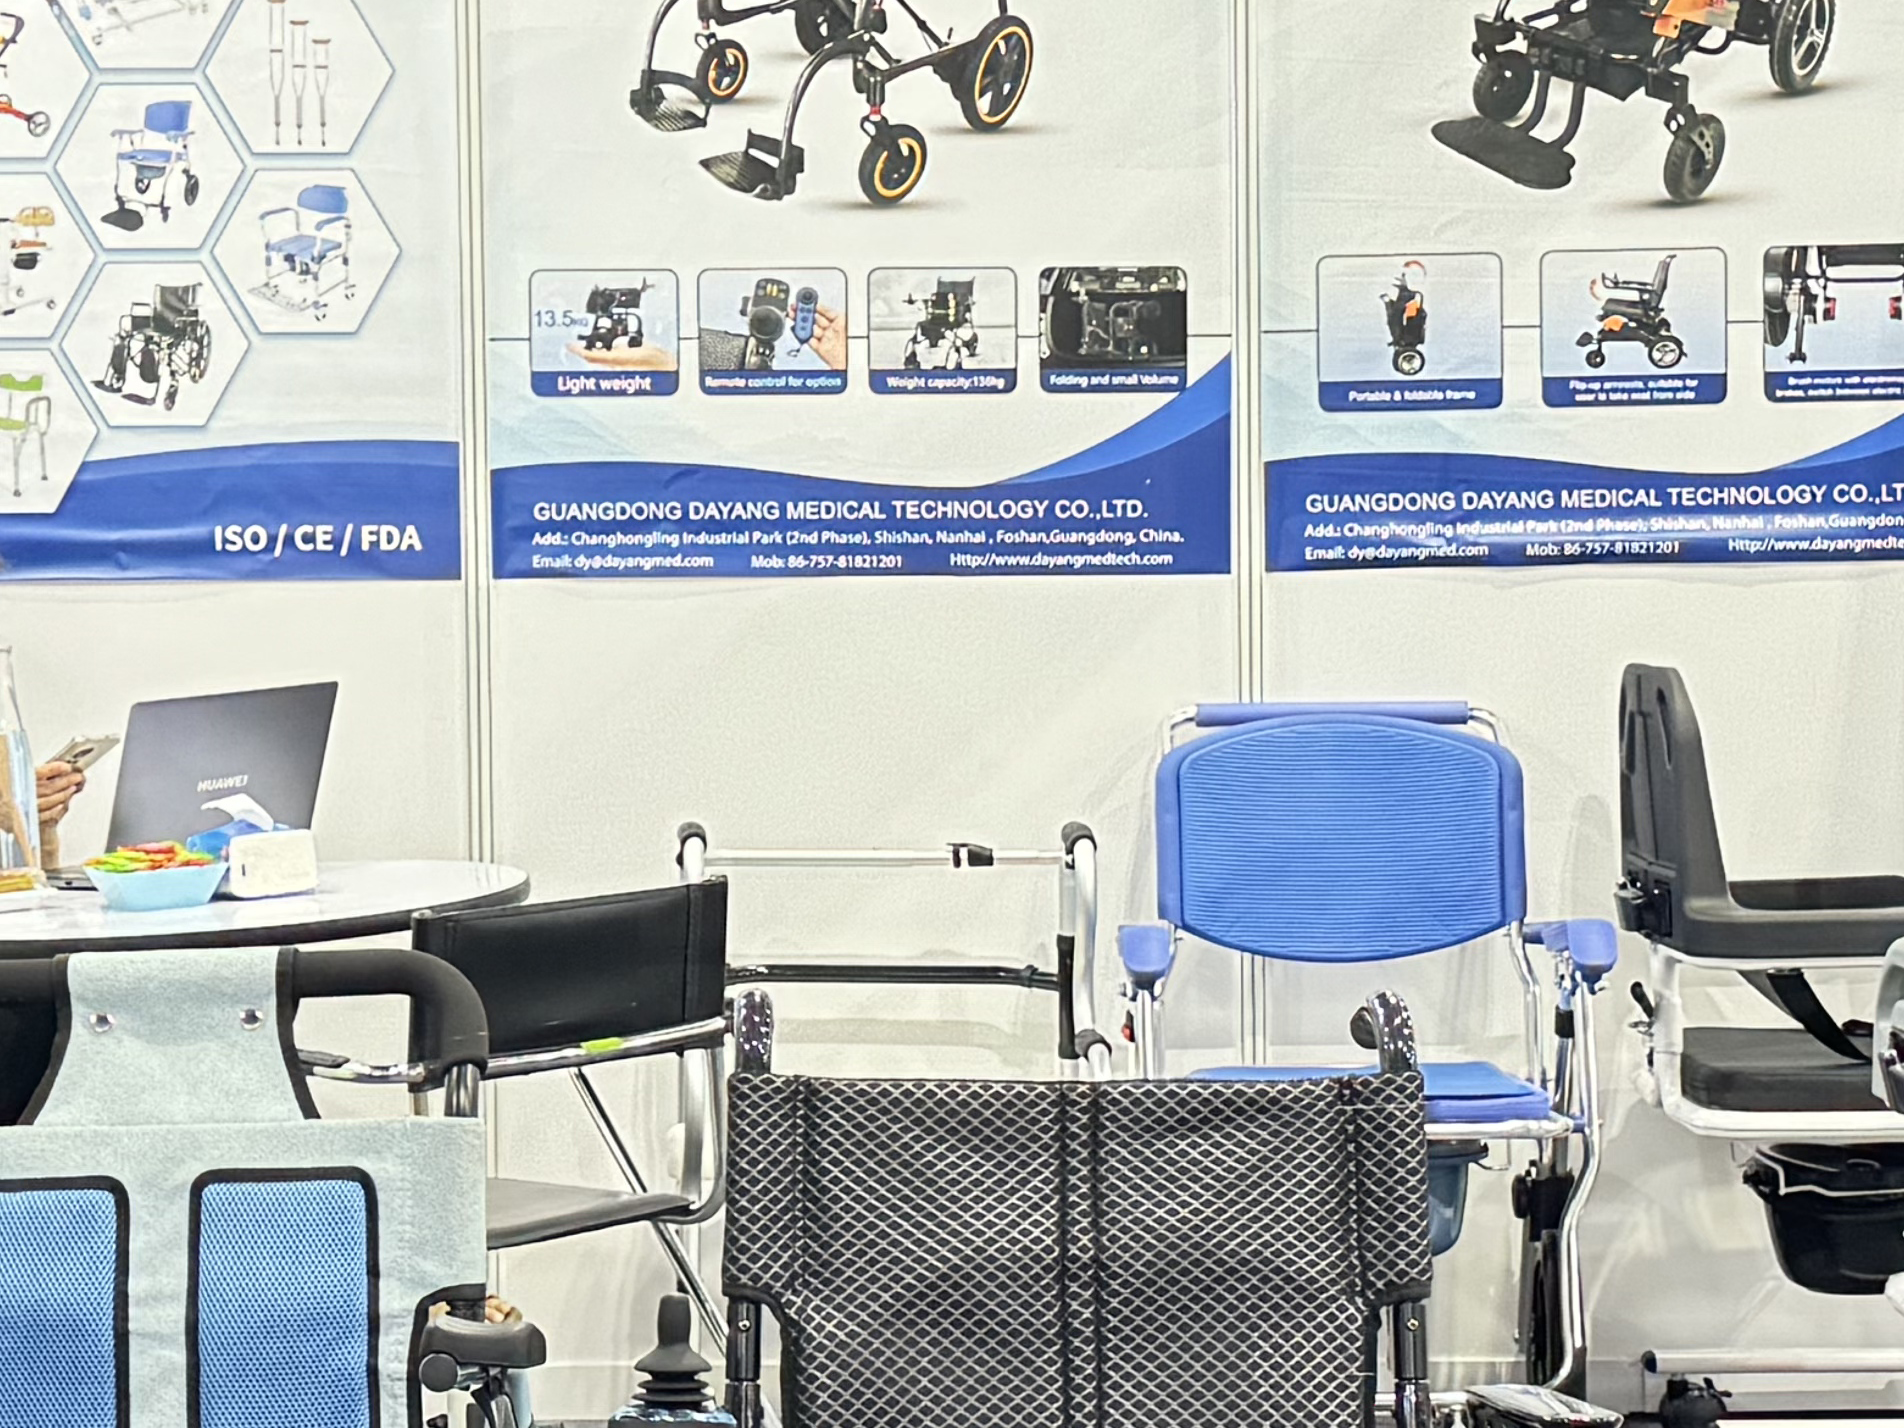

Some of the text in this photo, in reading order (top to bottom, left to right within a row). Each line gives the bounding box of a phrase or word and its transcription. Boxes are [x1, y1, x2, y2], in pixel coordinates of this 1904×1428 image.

[557, 375, 652, 394] Light weight
[805, 376, 841, 389] option
[1050, 374, 1088, 387] Folding
[1111, 374, 1138, 385] small
[1305, 491, 1456, 514] GUANGDONG
[1462, 489, 1555, 511] DAYANG
[1561, 487, 1662, 509] MEDICAL
[1666, 484, 1827, 507] TECHNOLOGY
[533, 499, 1148, 521] GUANGDONG DAYANG MEDICAL TECHNOLOGY CO.,LTD.
[214, 524, 268, 552] ISO
[294, 524, 335, 552] CE
[361, 524, 423, 552] FDA
[571, 531, 680, 547] Changhongling
[683, 531, 749, 545] Industrial
[752, 531, 784, 545] Park
[786, 531, 819, 546] (2nd
[874, 530, 933, 545] Shishan,
[1139, 529, 1185, 544] China.
[1344, 521, 1453, 539] Changhongling
[1456, 519, 1524, 535] Industrial
[1348, 544, 1489, 562] dy@dayangmed.com
[1526, 542, 1562, 556] Mob:
[574, 554, 714, 571] dy@dayangmed.com
[751, 554, 786, 568] Mob:
[197, 774, 248, 792] HUAWEI
